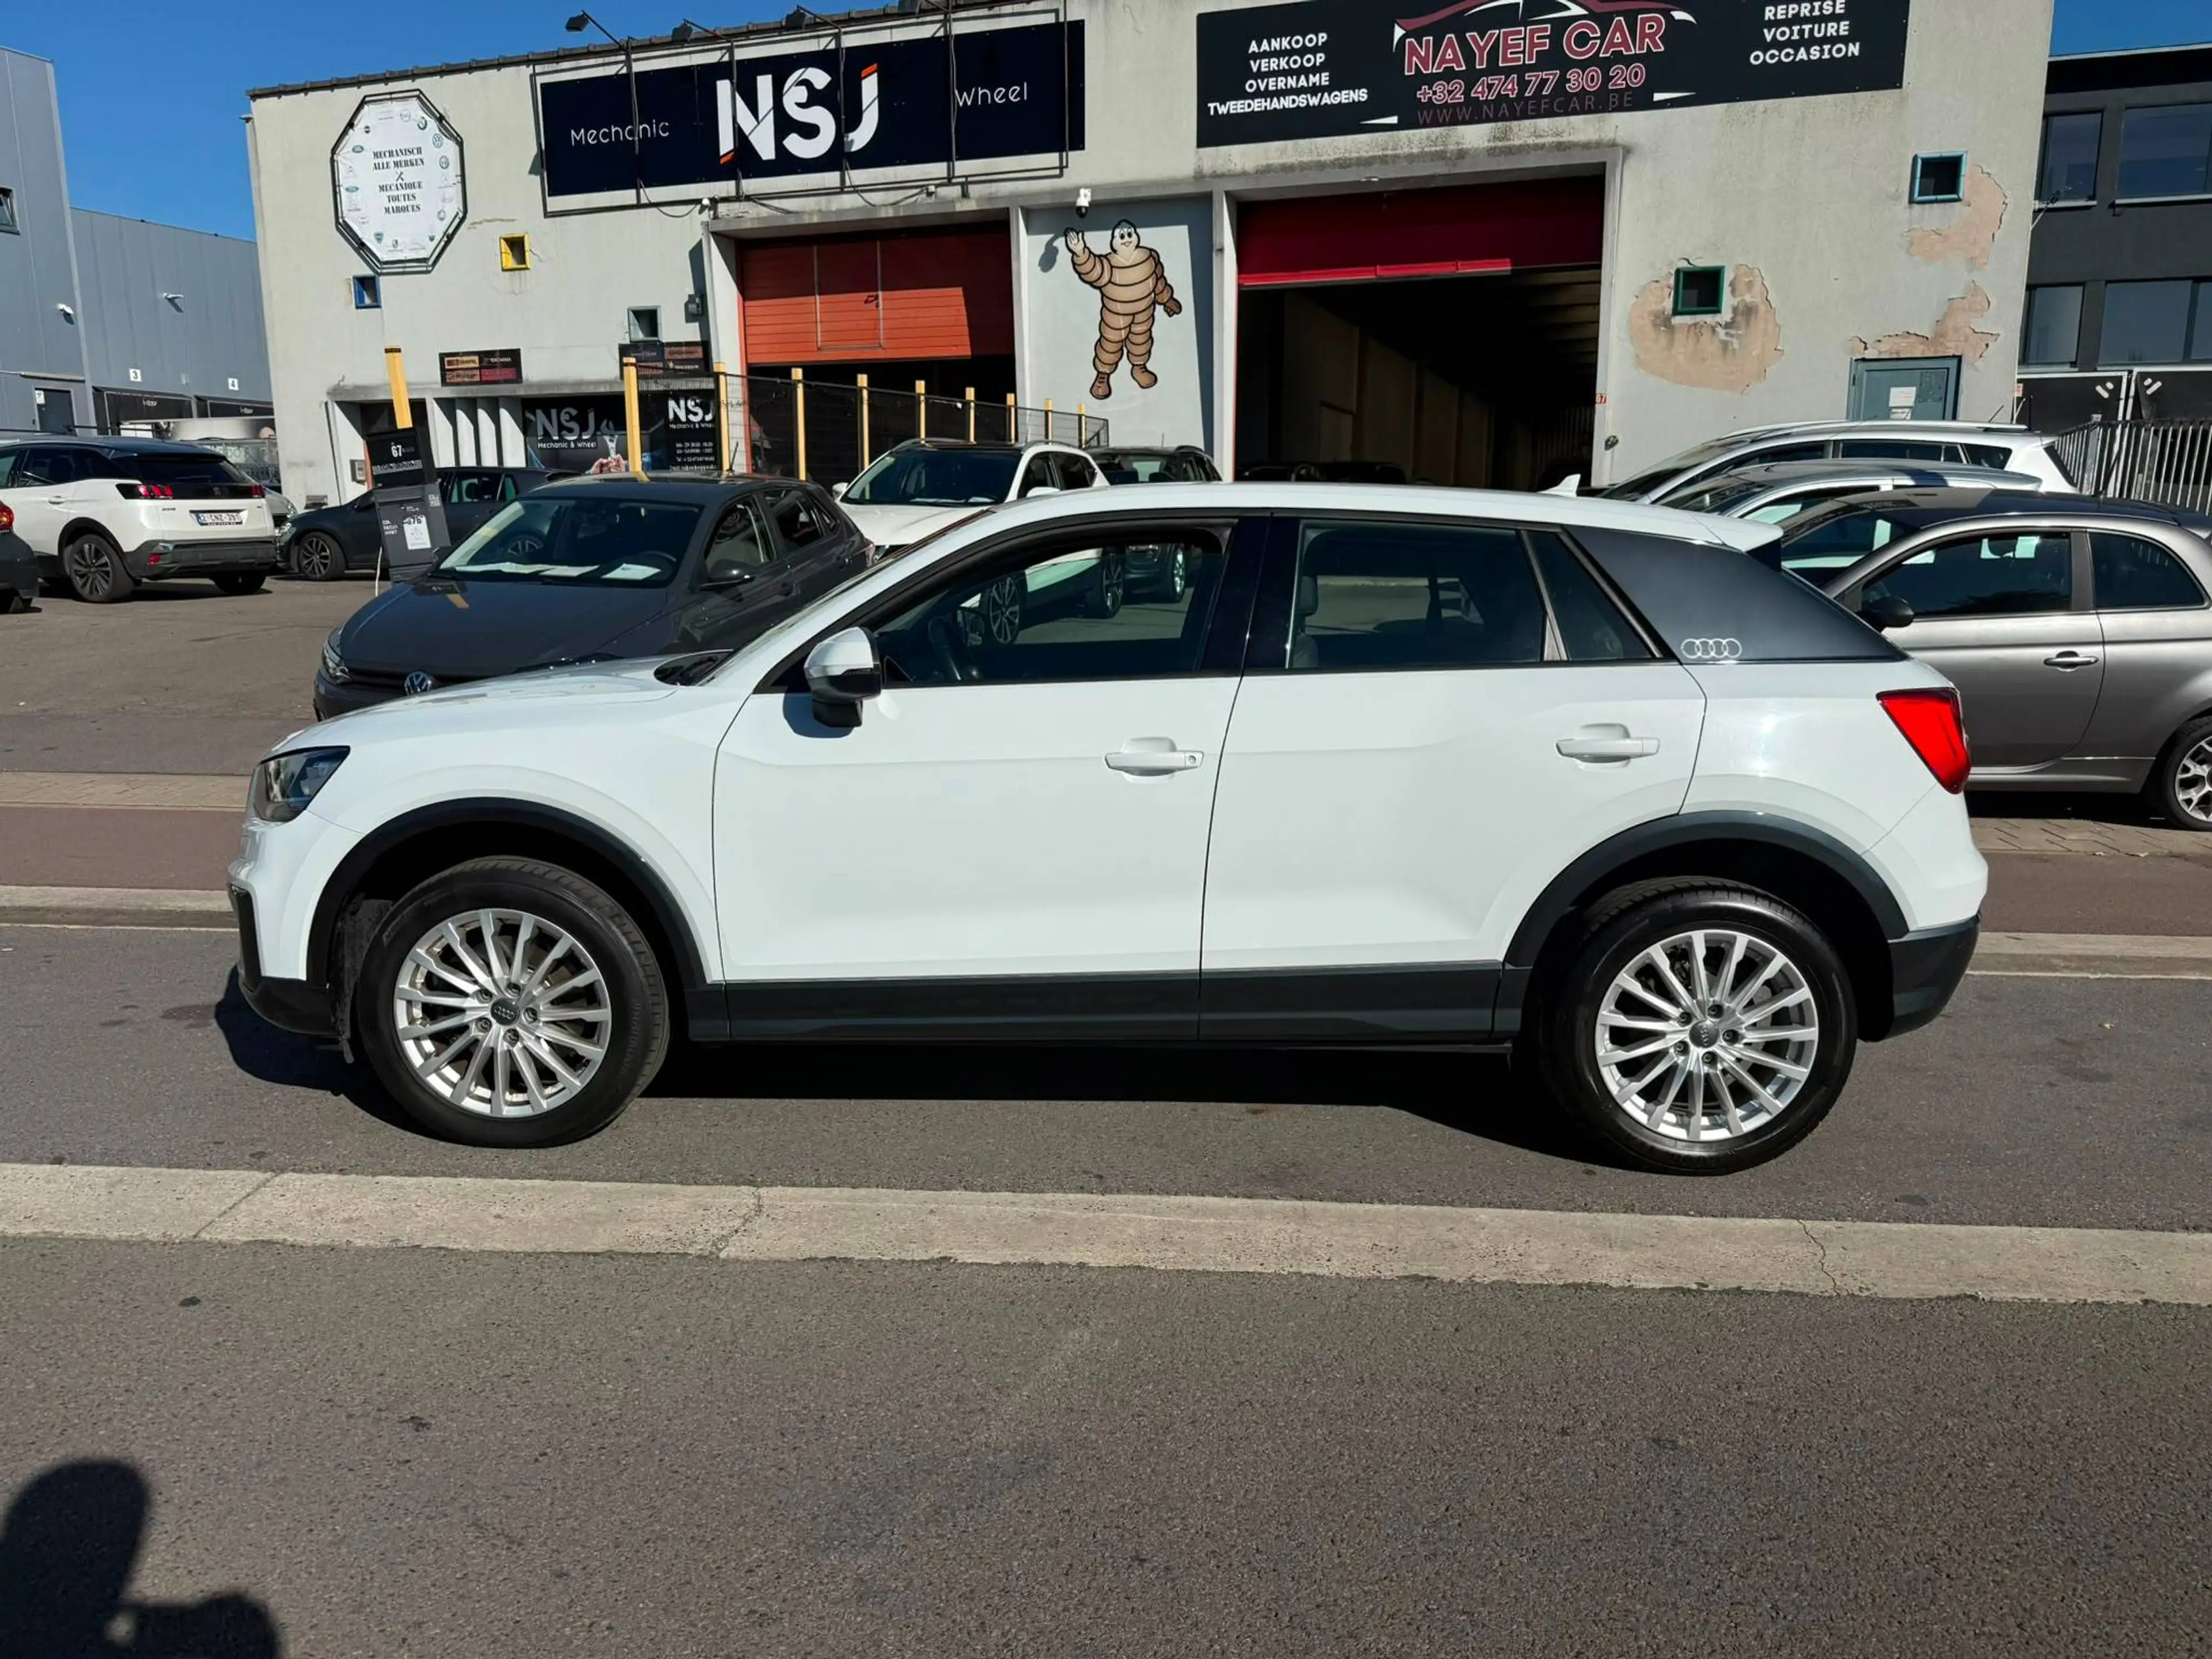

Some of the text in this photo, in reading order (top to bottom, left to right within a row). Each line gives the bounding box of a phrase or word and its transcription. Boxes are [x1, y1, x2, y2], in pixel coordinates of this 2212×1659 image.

[1764, 0, 1846, 21] REPRISE
[1248, 32, 1328, 54] AANKOOP
[1763, 21, 1850, 43] VOITURE
[1404, 13, 1665, 75] NAYEF CAR
[1749, 42, 1860, 65] OCCASION
[1250, 53, 1325, 73] VERKOOP
[1245, 72, 1330, 92] OVERNAME
[1417, 63, 1646, 104] +32 474 77 30 20
[956, 82, 1028, 107] Wheel
[1207, 89, 1368, 116] TWEEDEHANDSWAGENS
[715, 63, 879, 164] NSJ
[1417, 92, 1633, 125] WWW.NAYEFCAR.BE
[373, 147, 422, 159] MECHANISCH
[373, 158, 424, 171] ALLE MERKEN
[378, 181, 422, 192] MECANIQUE
[384, 204, 421, 214] MARQUES
[387, 193, 416, 203] TOUTES
[668, 397, 714, 422] NSJ
[536, 407, 595, 440] NSJ
[391, 445, 402, 457] 67
